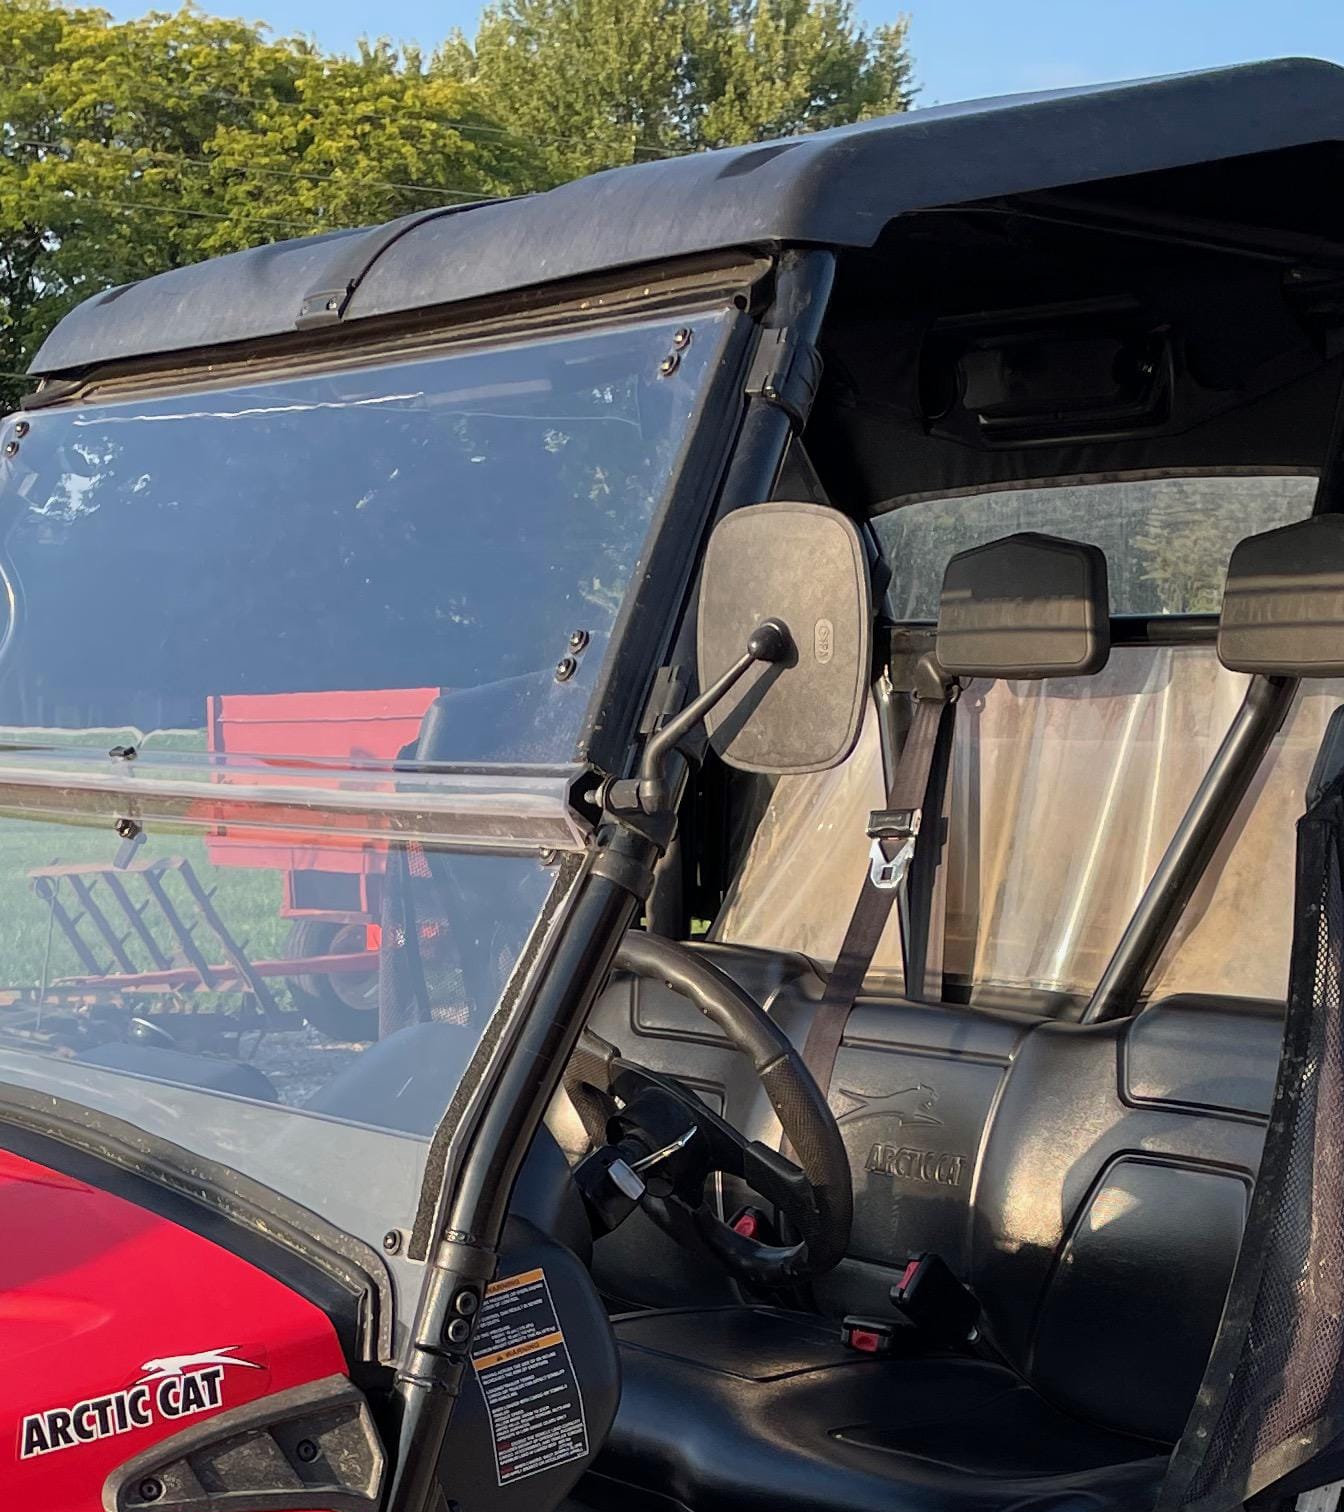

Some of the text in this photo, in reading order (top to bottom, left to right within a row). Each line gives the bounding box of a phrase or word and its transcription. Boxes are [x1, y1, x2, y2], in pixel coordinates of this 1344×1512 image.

[864, 1142, 967, 1186] ARCTIC CAT
[20, 1364, 223, 1460] ARCTIC CAT
